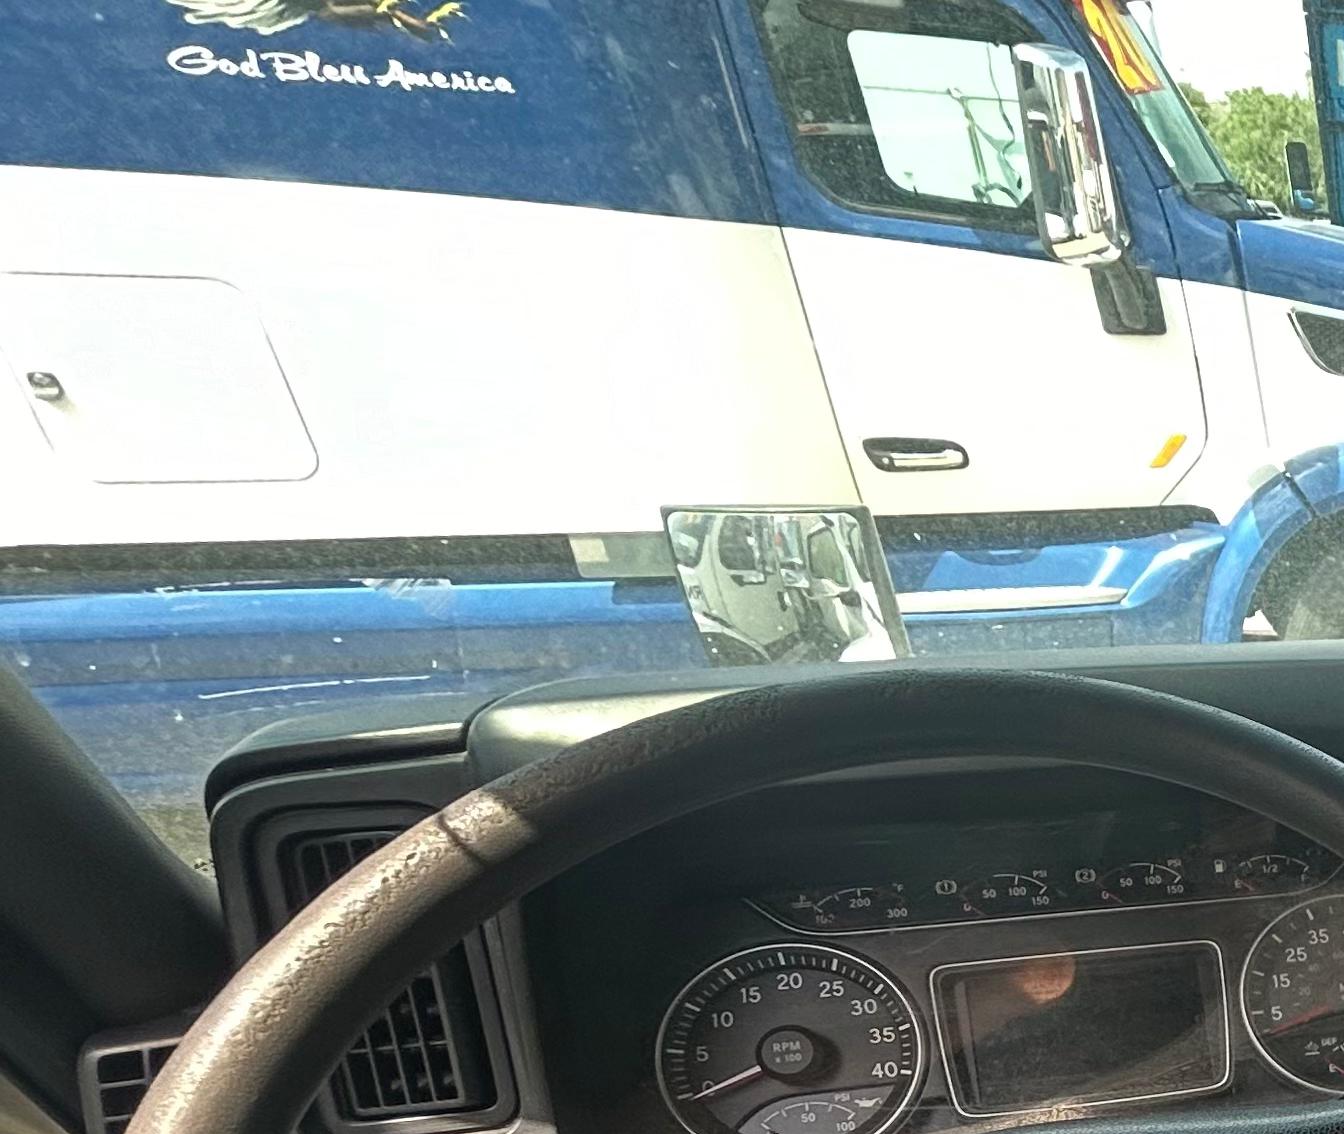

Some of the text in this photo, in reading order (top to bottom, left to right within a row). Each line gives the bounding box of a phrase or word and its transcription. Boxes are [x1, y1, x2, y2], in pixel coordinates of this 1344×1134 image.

[166, 45, 266, 79] God
[373, 59, 515, 94] America
[1119, 877, 1133, 887] 50
[1144, 875, 1162, 885] 100
[982, 889, 997, 899] 50
[1008, 886, 1027, 897] 100
[1167, 885, 1184, 895] 150
[850, 898, 871, 908] 200
[1031, 896, 1050, 906] 150
[886, 908, 908, 918] 300
[1308, 929, 1329, 944] 35
[1284, 947, 1307, 962] 25
[776, 972, 802, 990] 20
[1272, 974, 1291, 988] 15
[740, 986, 762, 1003] 15
[819, 981, 845, 998] 25
[850, 999, 878, 1015] 30
[1271, 1006, 1283, 1020] 5
[712, 1012, 734, 1028] 10
[869, 1028, 896, 1044] 35
[772, 1041, 801, 1052] RPM
[696, 1046, 709, 1062] 5
[784, 1053, 802, 1062] 100
[871, 1062, 898, 1078] 40
[801, 1113, 816, 1123] 50
[836, 1121, 856, 1132] 100
